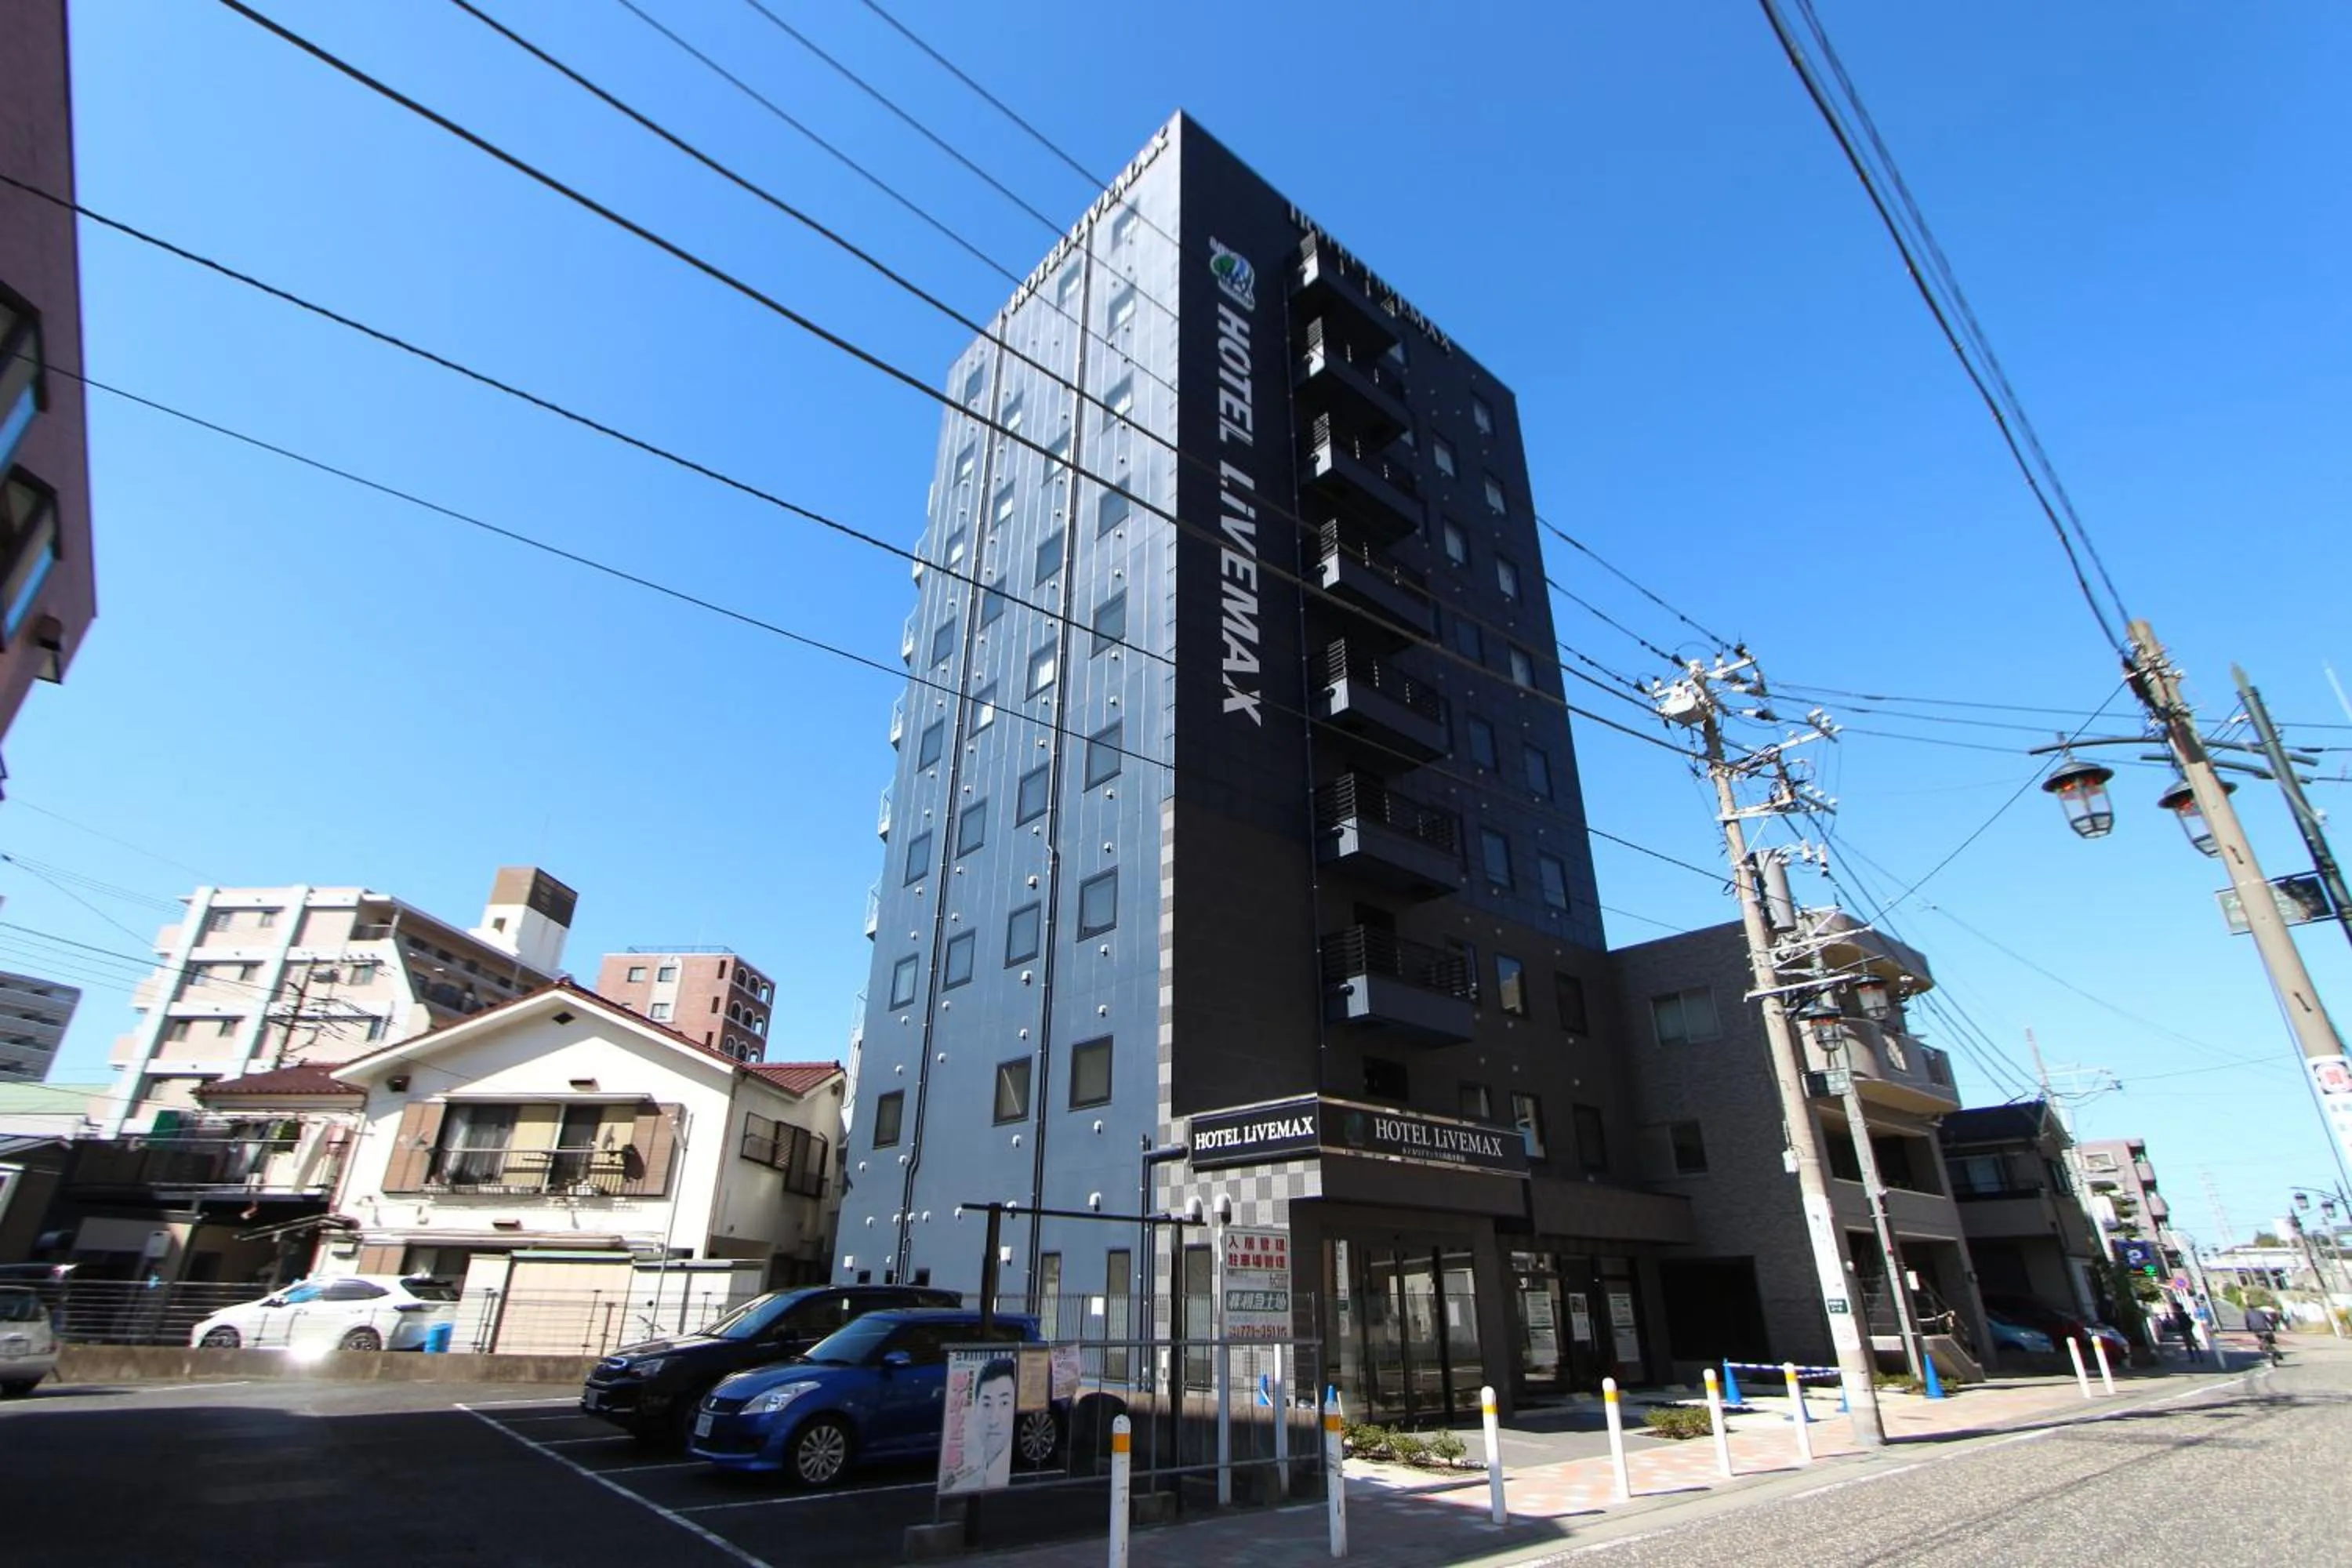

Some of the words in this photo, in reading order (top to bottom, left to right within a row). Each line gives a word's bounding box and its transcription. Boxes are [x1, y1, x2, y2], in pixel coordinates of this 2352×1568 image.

[1218, 303, 1255, 447] HOTEL
[1195, 1127, 1242, 1150] HOTEL
[1374, 1117, 1431, 1145] HOTEL
